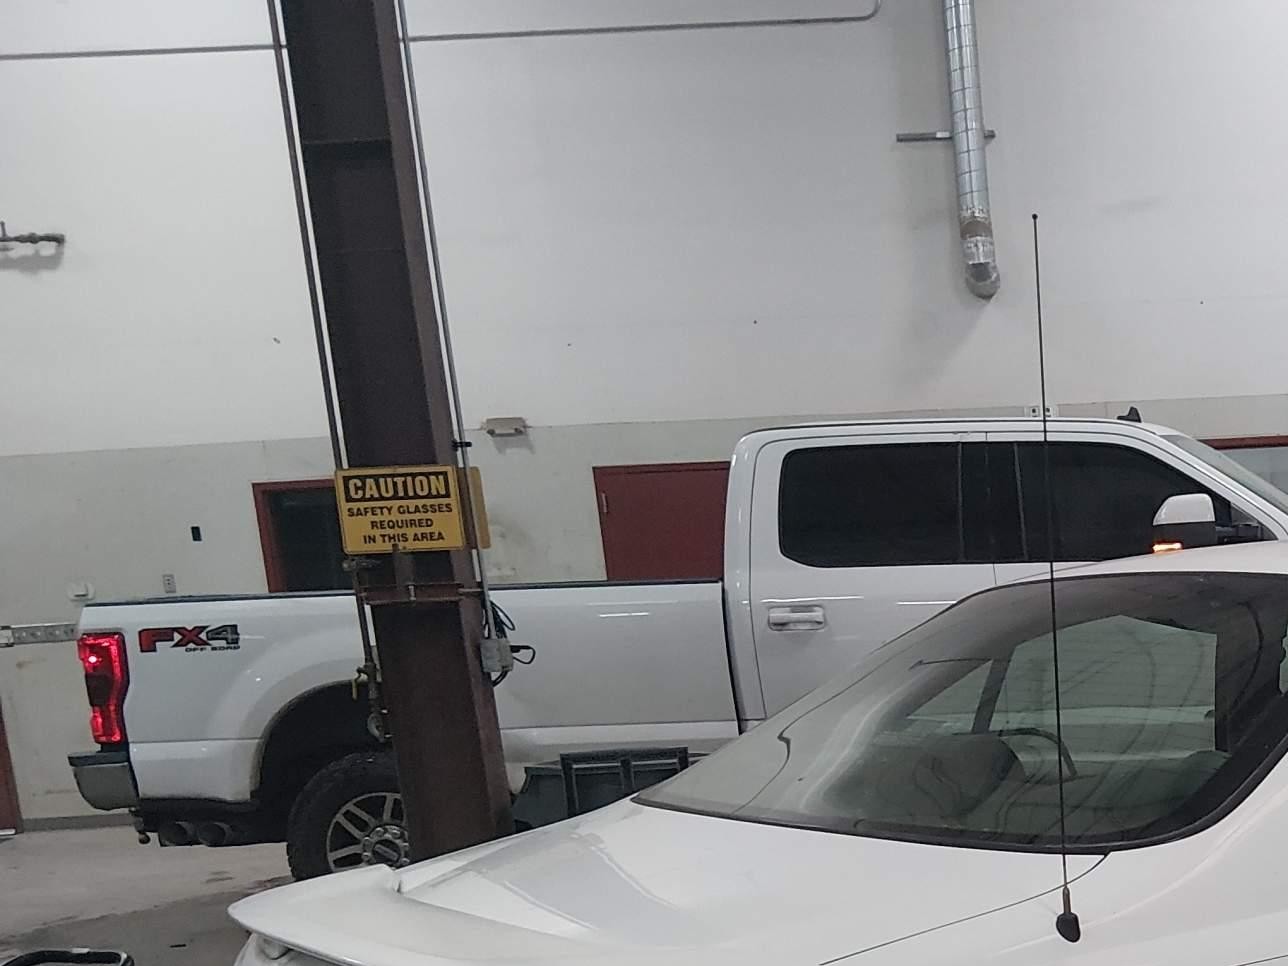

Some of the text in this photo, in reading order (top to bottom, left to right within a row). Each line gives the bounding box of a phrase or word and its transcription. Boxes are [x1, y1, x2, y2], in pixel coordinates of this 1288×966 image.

[348, 475, 446, 499] CAUTION
[347, 503, 453, 517] SAFETY GLASSES
[370, 518, 434, 530] REQUIRED
[363, 531, 445, 544] IN THIS AREA
[138, 624, 240, 653] FX4
